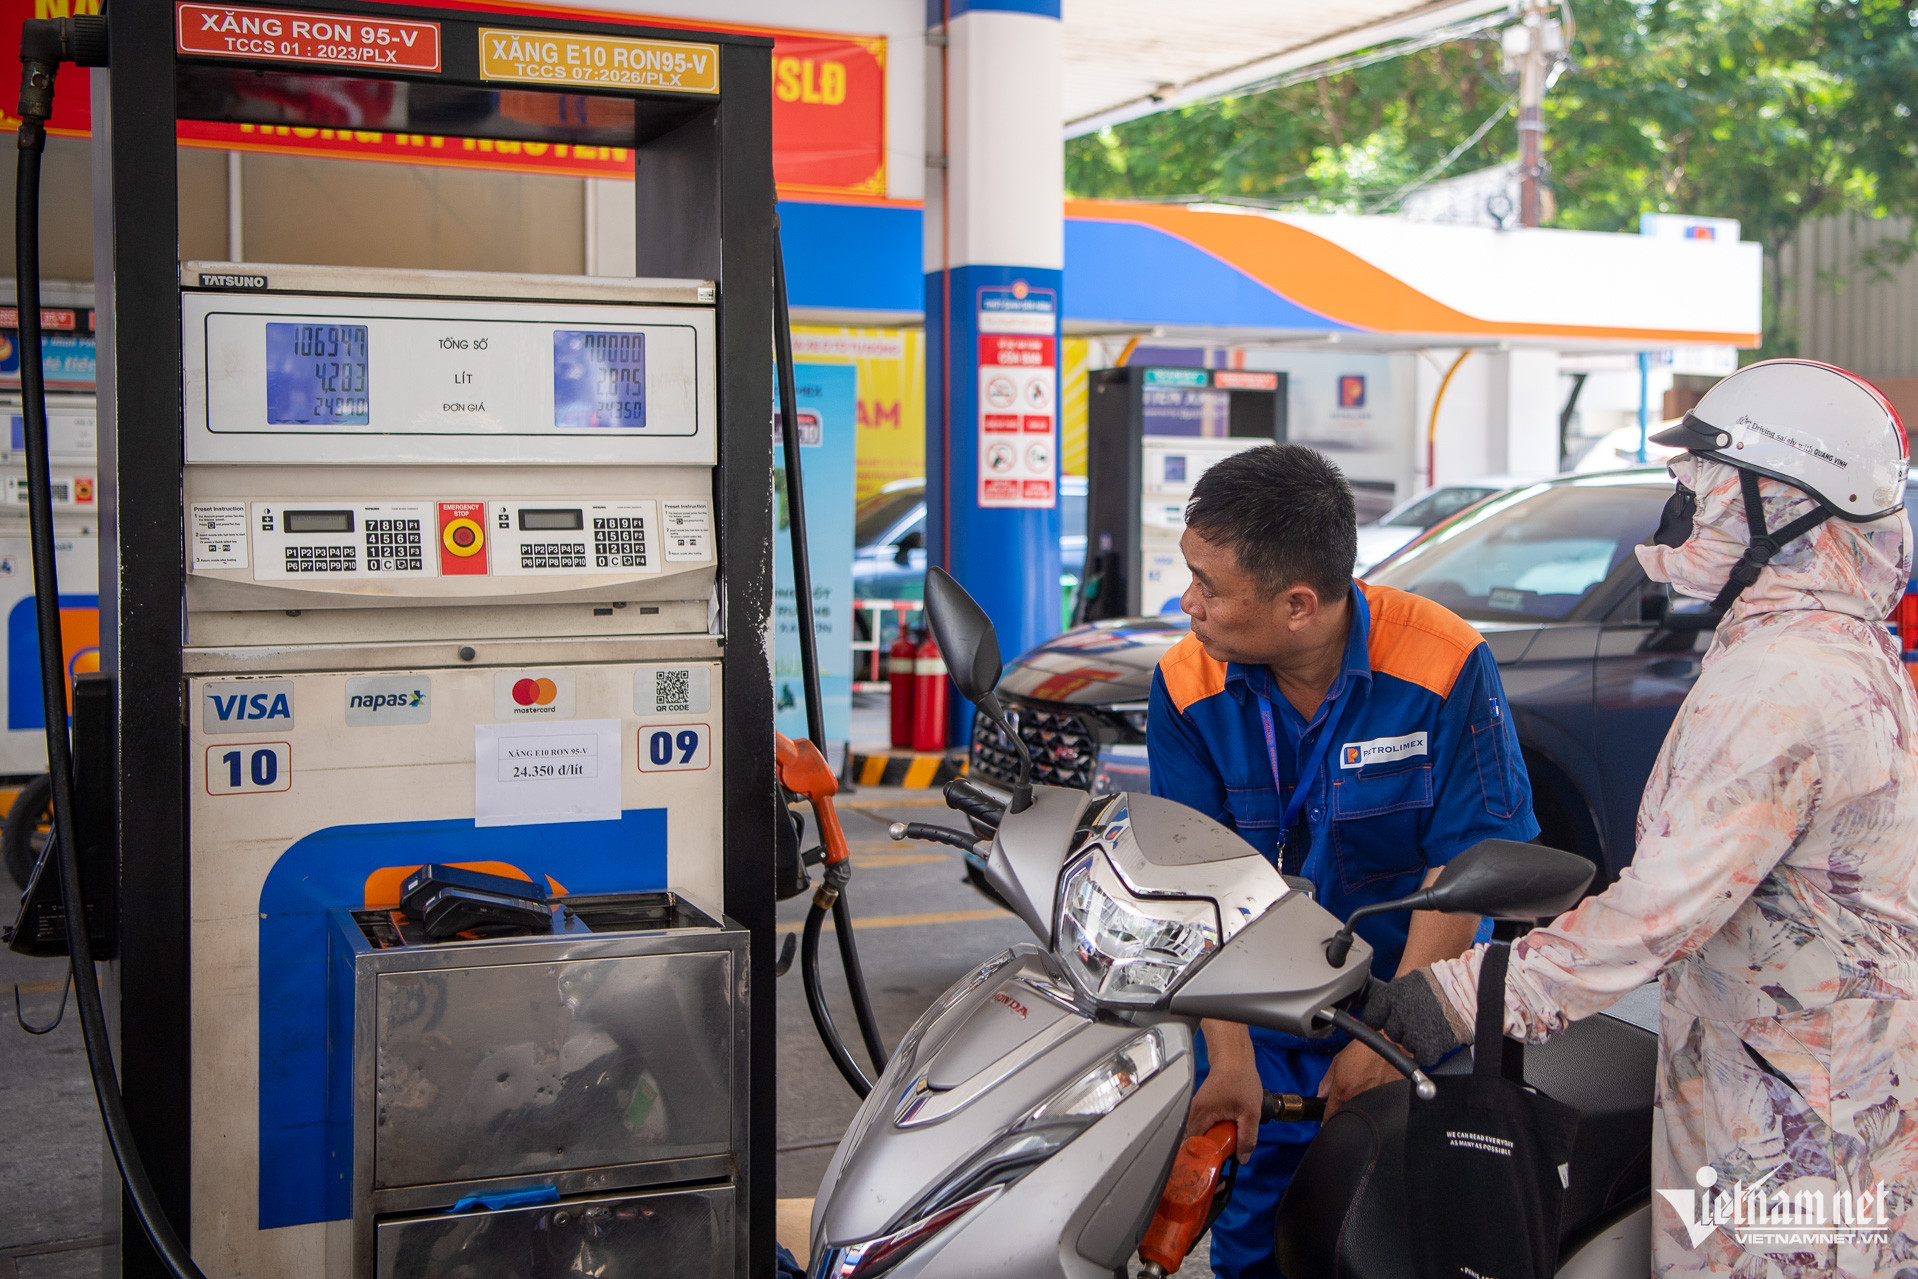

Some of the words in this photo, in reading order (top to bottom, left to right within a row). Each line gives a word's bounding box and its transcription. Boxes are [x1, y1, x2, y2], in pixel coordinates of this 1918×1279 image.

[200, 11, 283, 37] XĂNG
[293, 21, 352, 42] RON
[361, 27, 418, 47] 95-V
[224, 37, 275, 54] TCCS
[281, 41, 300, 56] 01
[317, 44, 397, 63] 2023/PLX
[492, 35, 558, 64] XĂNG
[567, 44, 607, 67] E10
[614, 48, 708, 75] RON95-V
[514, 63, 567, 78] TCCS
[572, 67, 682, 87] 07:2026/PLX
[772, 56, 847, 106] SLĐ
[202, 275, 264, 287] TATSUNO
[294, 326, 365, 357] 106947
[438, 336, 469, 350] TỔNG
[473, 337, 489, 350] SỐ
[454, 370, 473, 384] LÍT
[442, 403, 465, 412] ĐƠN
[467, 402, 485, 412] GIÁ
[1751, 422, 1776, 439] Driving
[1813, 448, 1833, 462] QUANG
[1834, 457, 1848, 469] VINH
[368, 521, 376, 530] 7
[382, 521, 390, 530] 8
[396, 520, 404, 530] 9
[595, 519, 603, 528] 7
[609, 519, 616, 528] 8
[621, 519, 629, 528] 9
[369, 534, 376, 544] 4
[383, 534, 390, 543] 5
[397, 534, 404, 543] 6
[597, 531, 604, 541] 4
[610, 531, 617, 541] 5
[622, 531, 630, 541] 6
[286, 549, 297, 557] P1
[301, 548, 312, 557] P2
[315, 548, 327, 557] P3
[329, 548, 341, 556] P4
[343, 548, 355, 556] P5
[370, 547, 376, 557] 1
[383, 547, 391, 557] 2
[397, 547, 405, 556] 3
[521, 546, 531, 554] P1
[535, 545, 545, 554] P2
[548, 545, 558, 554] P3
[561, 545, 571, 553] P4
[574, 545, 584, 553] P5
[598, 544, 604, 553] 1
[610, 544, 618, 553] 2
[623, 544, 631, 553] 3
[287, 562, 298, 570] P6
[301, 562, 313, 570] P7
[315, 562, 327, 570] P8
[330, 561, 341, 570] P9
[343, 561, 356, 569] P10
[370, 560, 378, 570] 0
[383, 560, 392, 570] C
[522, 558, 533, 567] P6
[535, 558, 546, 566] P7
[548, 558, 559, 566] P8
[562, 558, 572, 566] P9
[575, 557, 585, 566] P10
[598, 557, 606, 566] 0
[611, 556, 619, 566] C
[206, 693, 291, 721] VISA
[350, 692, 407, 712] napas
[656, 704, 667, 712] QR
[513, 705, 556, 714] mastercard
[508, 748, 533, 759] XĂNG
[535, 749, 549, 757] E10
[550, 748, 570, 756] RON
[571, 747, 588, 756] 95-V
[650, 730, 699, 766] 09
[223, 749, 278, 788] 10
[513, 765, 554, 778] 24.350
[558, 763, 583, 776] đ/lít
[991, 991, 1028, 1019] HONDA
[1456, 1131, 1469, 1139] CAN
[1458, 1140, 1475, 1148] MANY
[1474, 1142, 1482, 1150] AS
[1482, 1143, 1511, 1156] POSSIBLE
